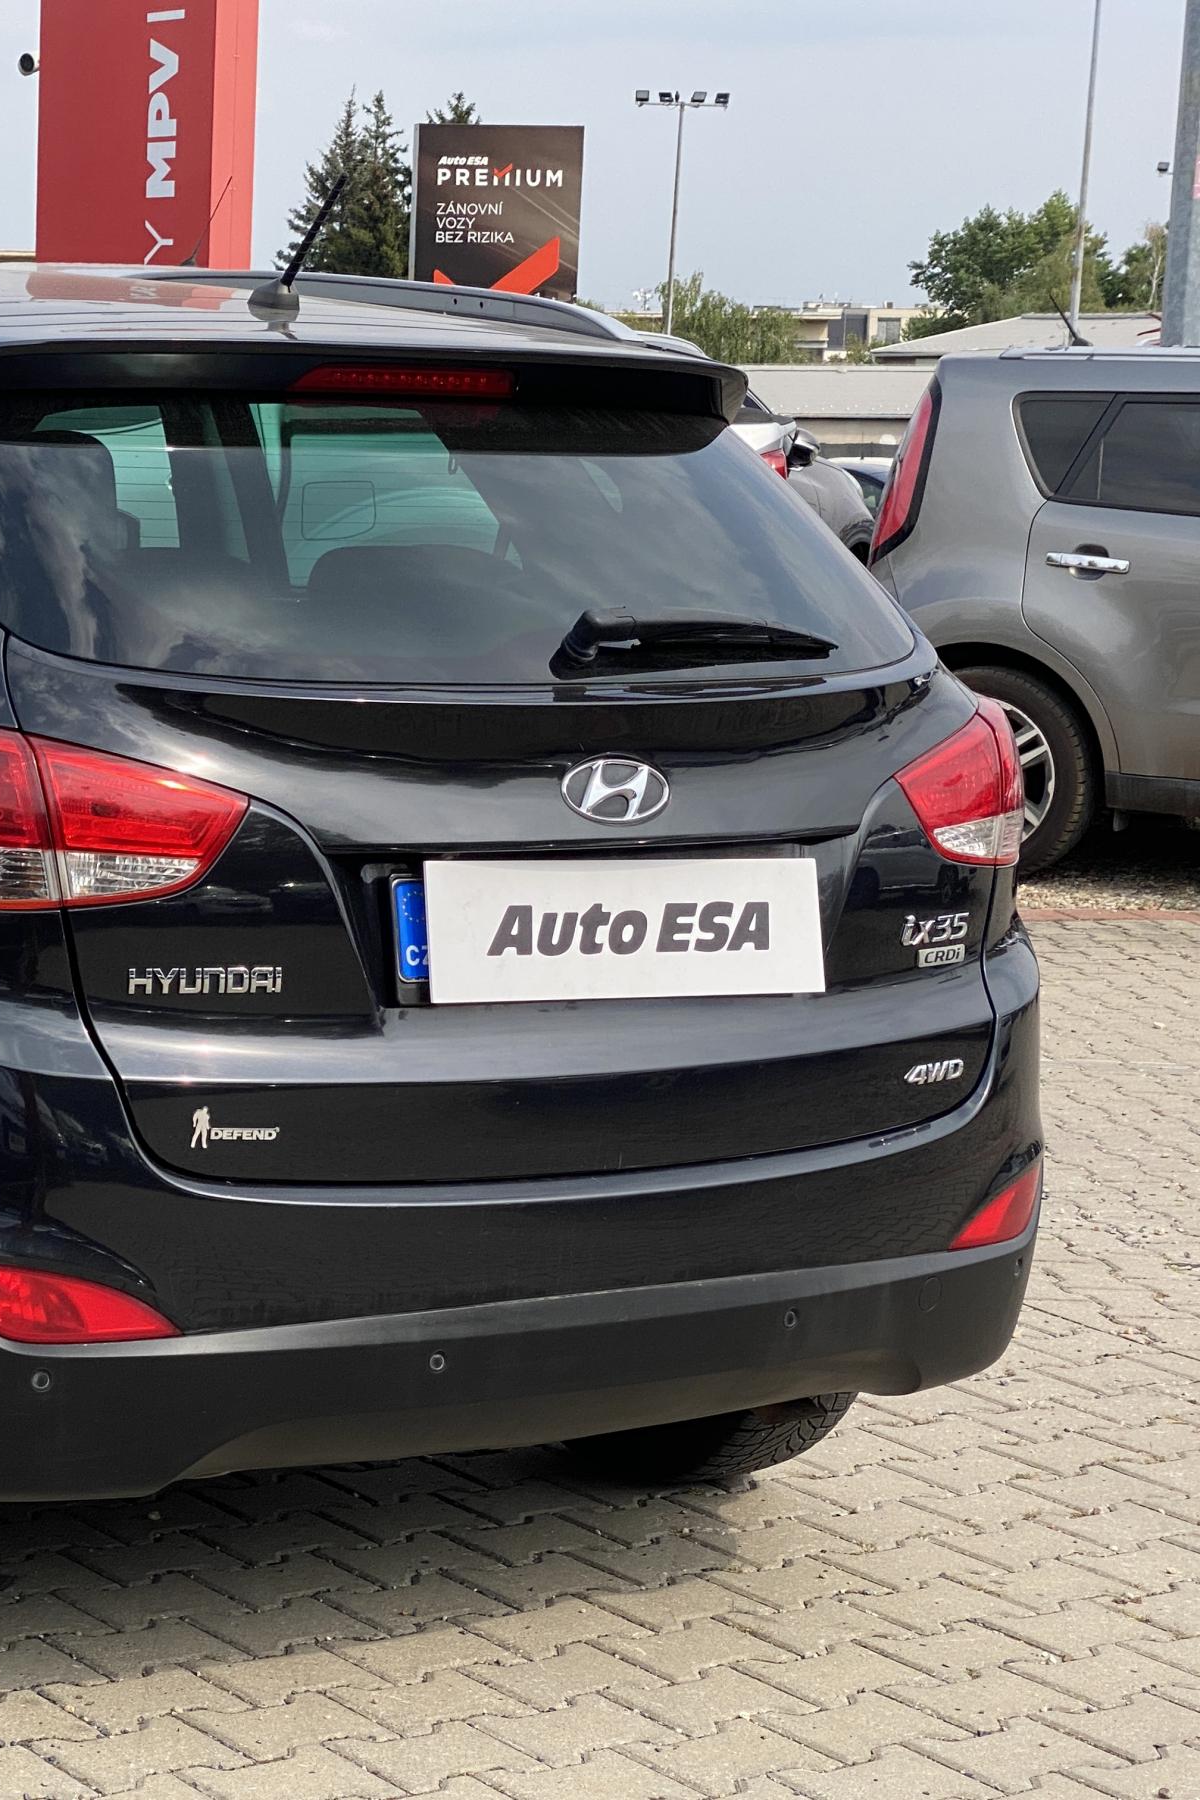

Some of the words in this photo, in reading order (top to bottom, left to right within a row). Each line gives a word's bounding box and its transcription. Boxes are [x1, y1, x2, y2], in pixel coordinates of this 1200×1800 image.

[145, 38, 180, 198] MPV
[438, 155, 467, 166] Auto
[466, 155, 489, 166] ESA
[436, 163, 564, 187] PREMIUM
[436, 201, 503, 215] ZÁNOVNÍ
[436, 217, 476, 229] VOZY
[435, 231, 464, 243] BEZ
[467, 231, 515, 243] RIZIKA
[486, 903, 648, 957] Auto
[656, 901, 770, 953] ESA
[901, 912, 970, 946] ix35
[924, 948, 961, 965] CRDi
[128, 966, 283, 995] HYUNDAI
[904, 1058, 965, 1085] 4WD
